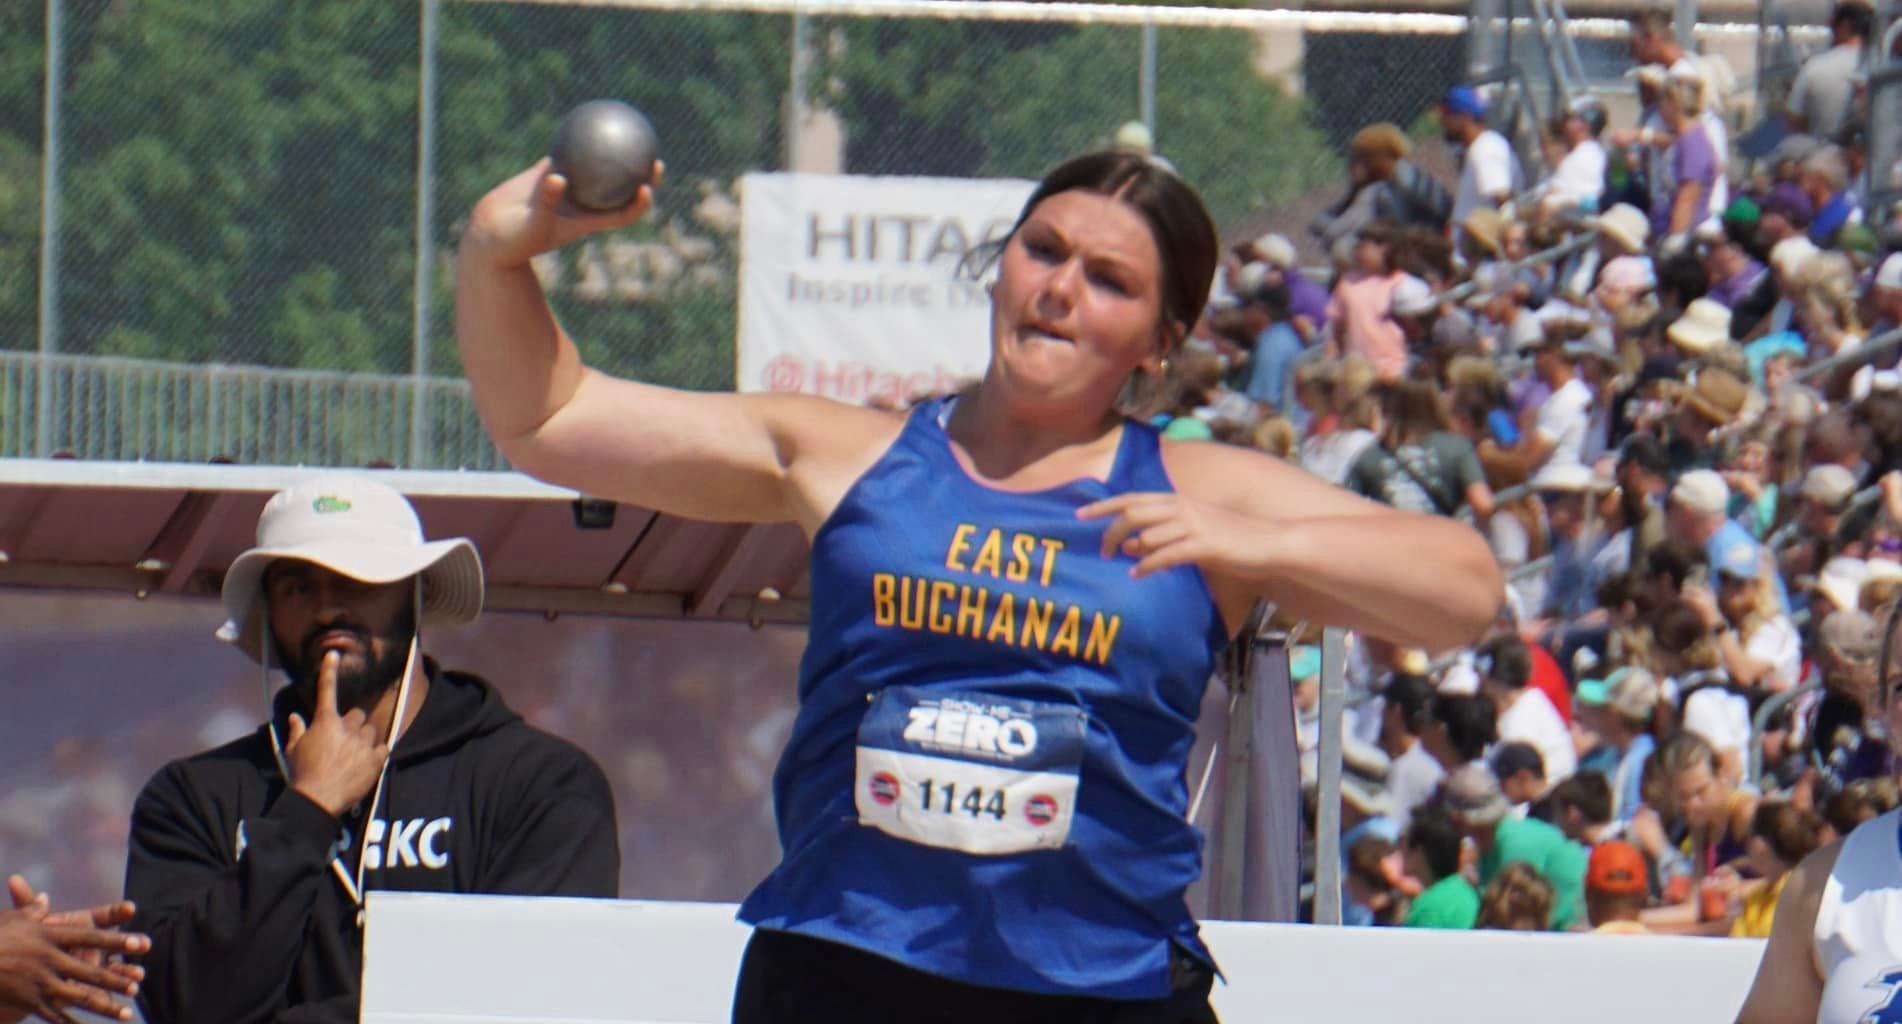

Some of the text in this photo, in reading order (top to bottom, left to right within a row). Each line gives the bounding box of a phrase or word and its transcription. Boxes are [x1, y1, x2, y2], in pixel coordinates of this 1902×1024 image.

[788, 272, 930, 308] Inspire
[763, 353, 975, 401] @Hitach
[946, 523, 1064, 588] EAST
[873, 573, 1121, 666] BUCHANAN
[903, 706, 1038, 757] ZERO
[919, 778, 1007, 821] 1144
